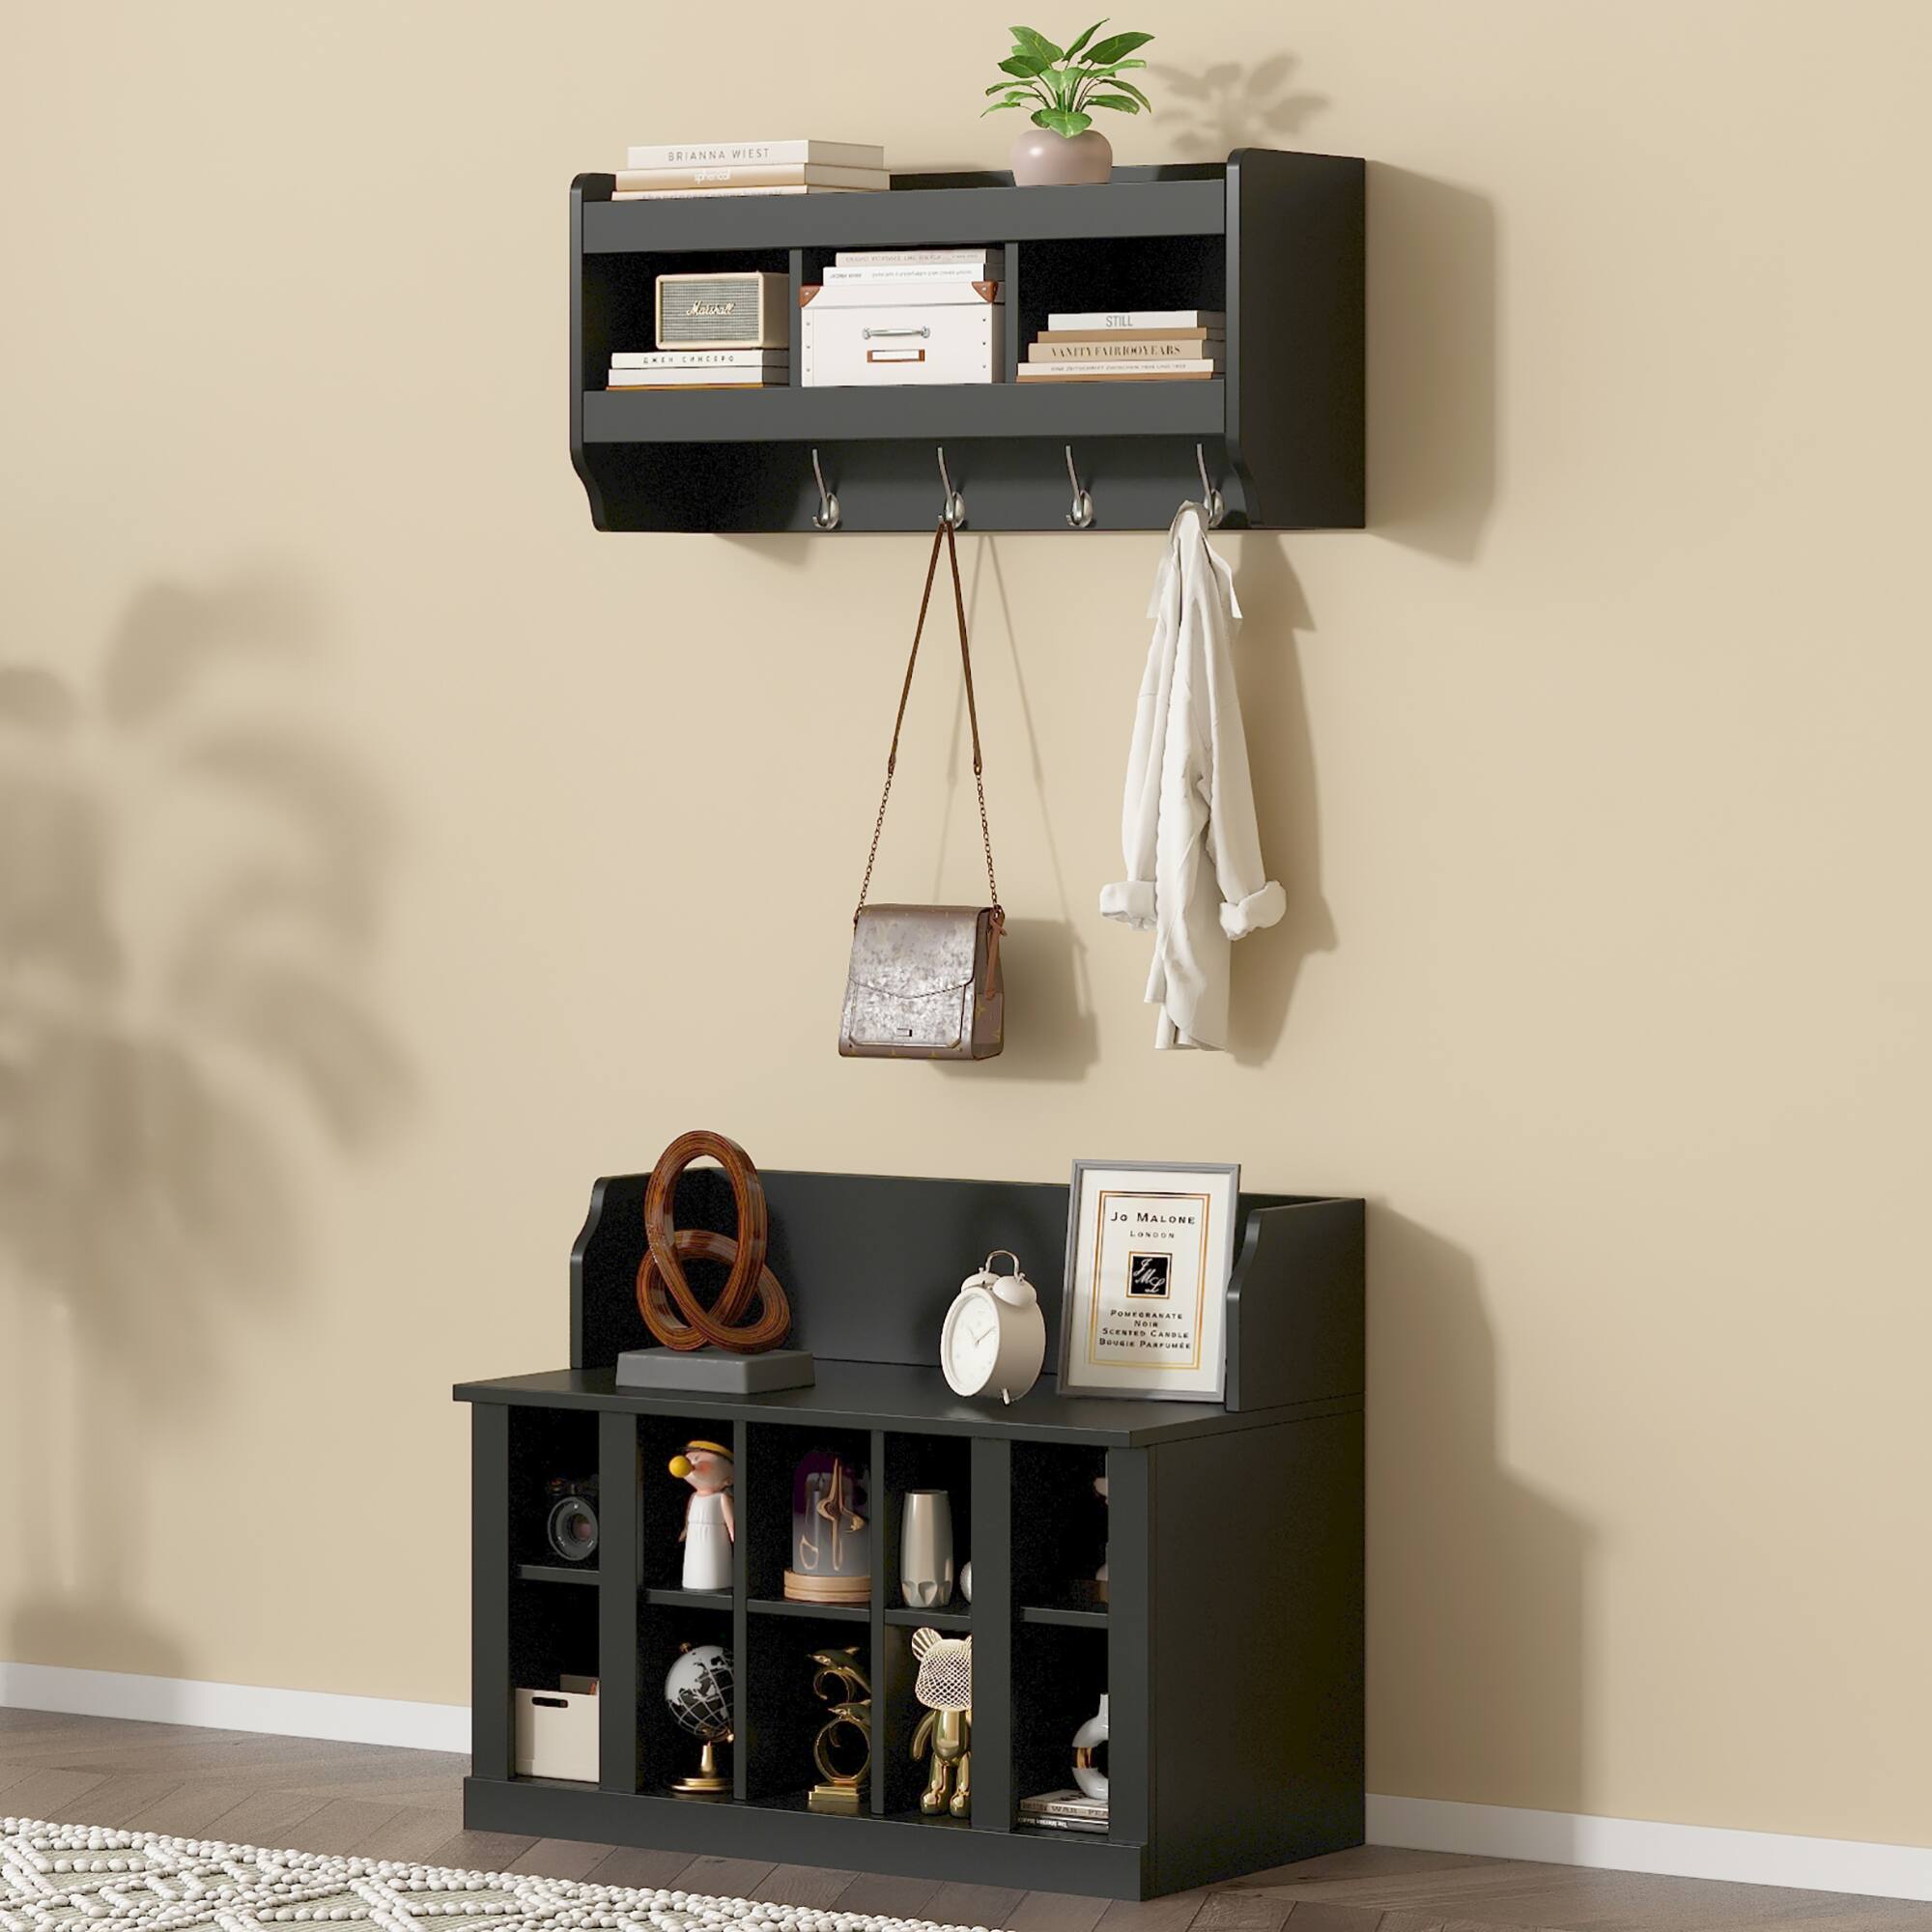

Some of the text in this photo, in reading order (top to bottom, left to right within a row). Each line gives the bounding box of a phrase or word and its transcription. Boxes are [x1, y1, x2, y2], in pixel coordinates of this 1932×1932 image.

[668, 148, 770, 162] BRIANNA WIEST
[687, 300, 736, 317] Marshall
[1105, 315, 1133, 327] STILL
[1111, 1309, 1182, 1320] POMEGRANATE
[1151, 1329, 1189, 1339] CANDLE
